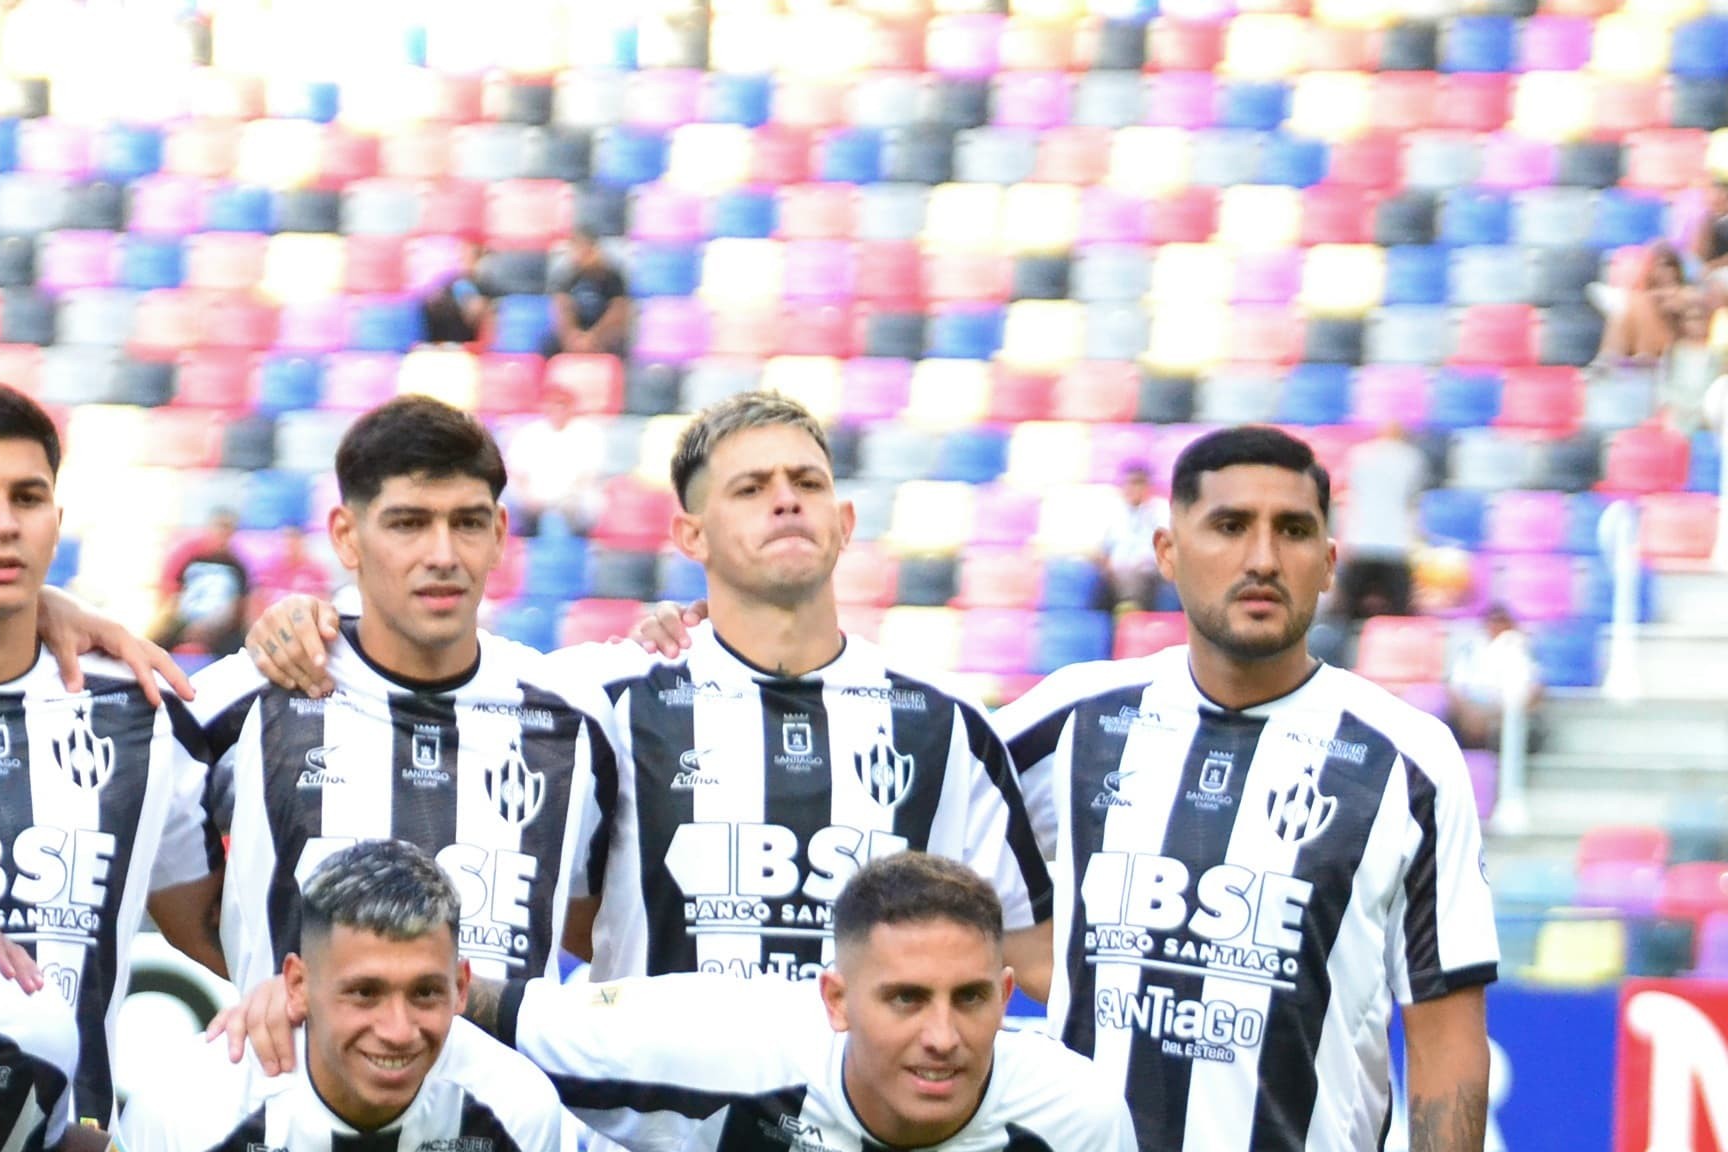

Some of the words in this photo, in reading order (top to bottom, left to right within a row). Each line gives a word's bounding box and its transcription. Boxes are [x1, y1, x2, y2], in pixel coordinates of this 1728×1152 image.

[435, 843, 538, 928] SE
[1126, 853, 1314, 951] BSE
[684, 901, 771, 922] BANCO
[459, 926, 529, 954] TIAGO
[1084, 931, 1154, 953] BANCO
[1164, 937, 1298, 976] SANTIAGO
[779, 1112, 824, 1143] ISM
